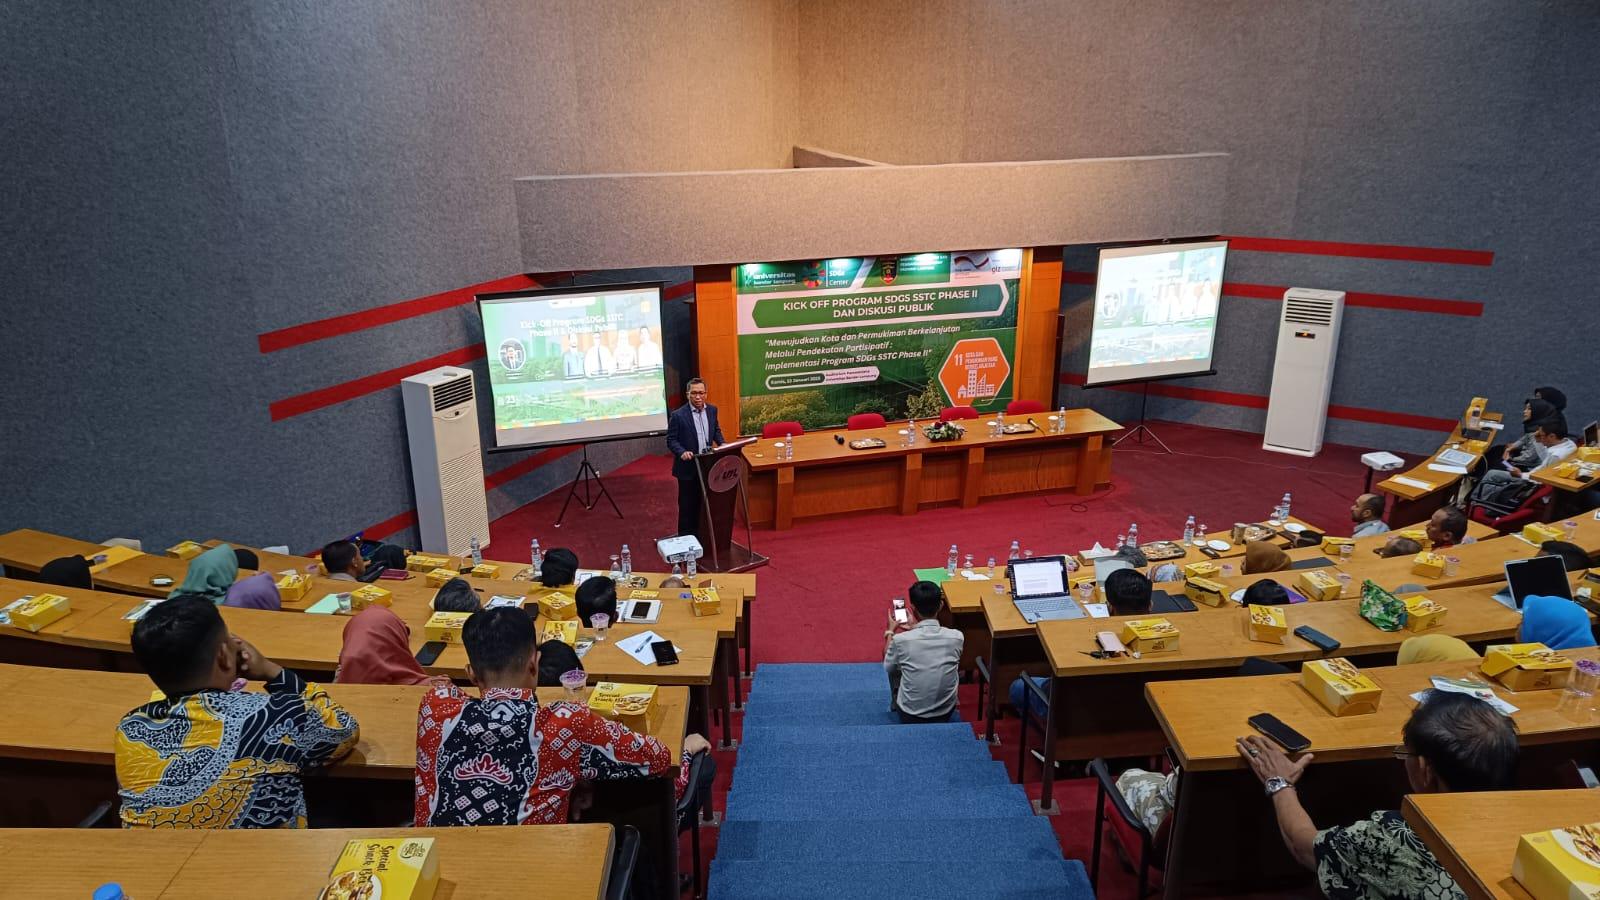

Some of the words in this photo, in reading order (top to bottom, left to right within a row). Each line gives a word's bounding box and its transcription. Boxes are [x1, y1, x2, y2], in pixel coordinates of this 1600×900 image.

[783, 301, 808, 311] KICK
[810, 300, 830, 310] OFF
[832, 296, 882, 308] PROGRAM
[884, 294, 911, 304] SDGS
[912, 292, 936, 302] SSTC
[938, 290, 970, 300] PHASE
[972, 290, 978, 298] II
[833, 308, 855, 318] DAN
[858, 304, 896, 316] DISKUSI
[898, 302, 934, 313] PUBLIK
[820, 334, 840, 342] Kota
[858, 328, 906, 340] Permukiman
[907, 326, 961, 336] Berkelanjutan
[765, 348, 795, 358] Melalui
[796, 345, 844, 356] Pendekatan
[845, 342, 890, 352] Partisipatif
[765, 360, 820, 370] Implementasi
[820, 356, 854, 366] Program
[855, 354, 876, 362] SDGs
[878, 352, 898, 361] SSTC
[898, 350, 921, 359] Phase
[954, 354, 963, 366] 11
[362, 843, 381, 866] Snack
[376, 844, 395, 872] Special
